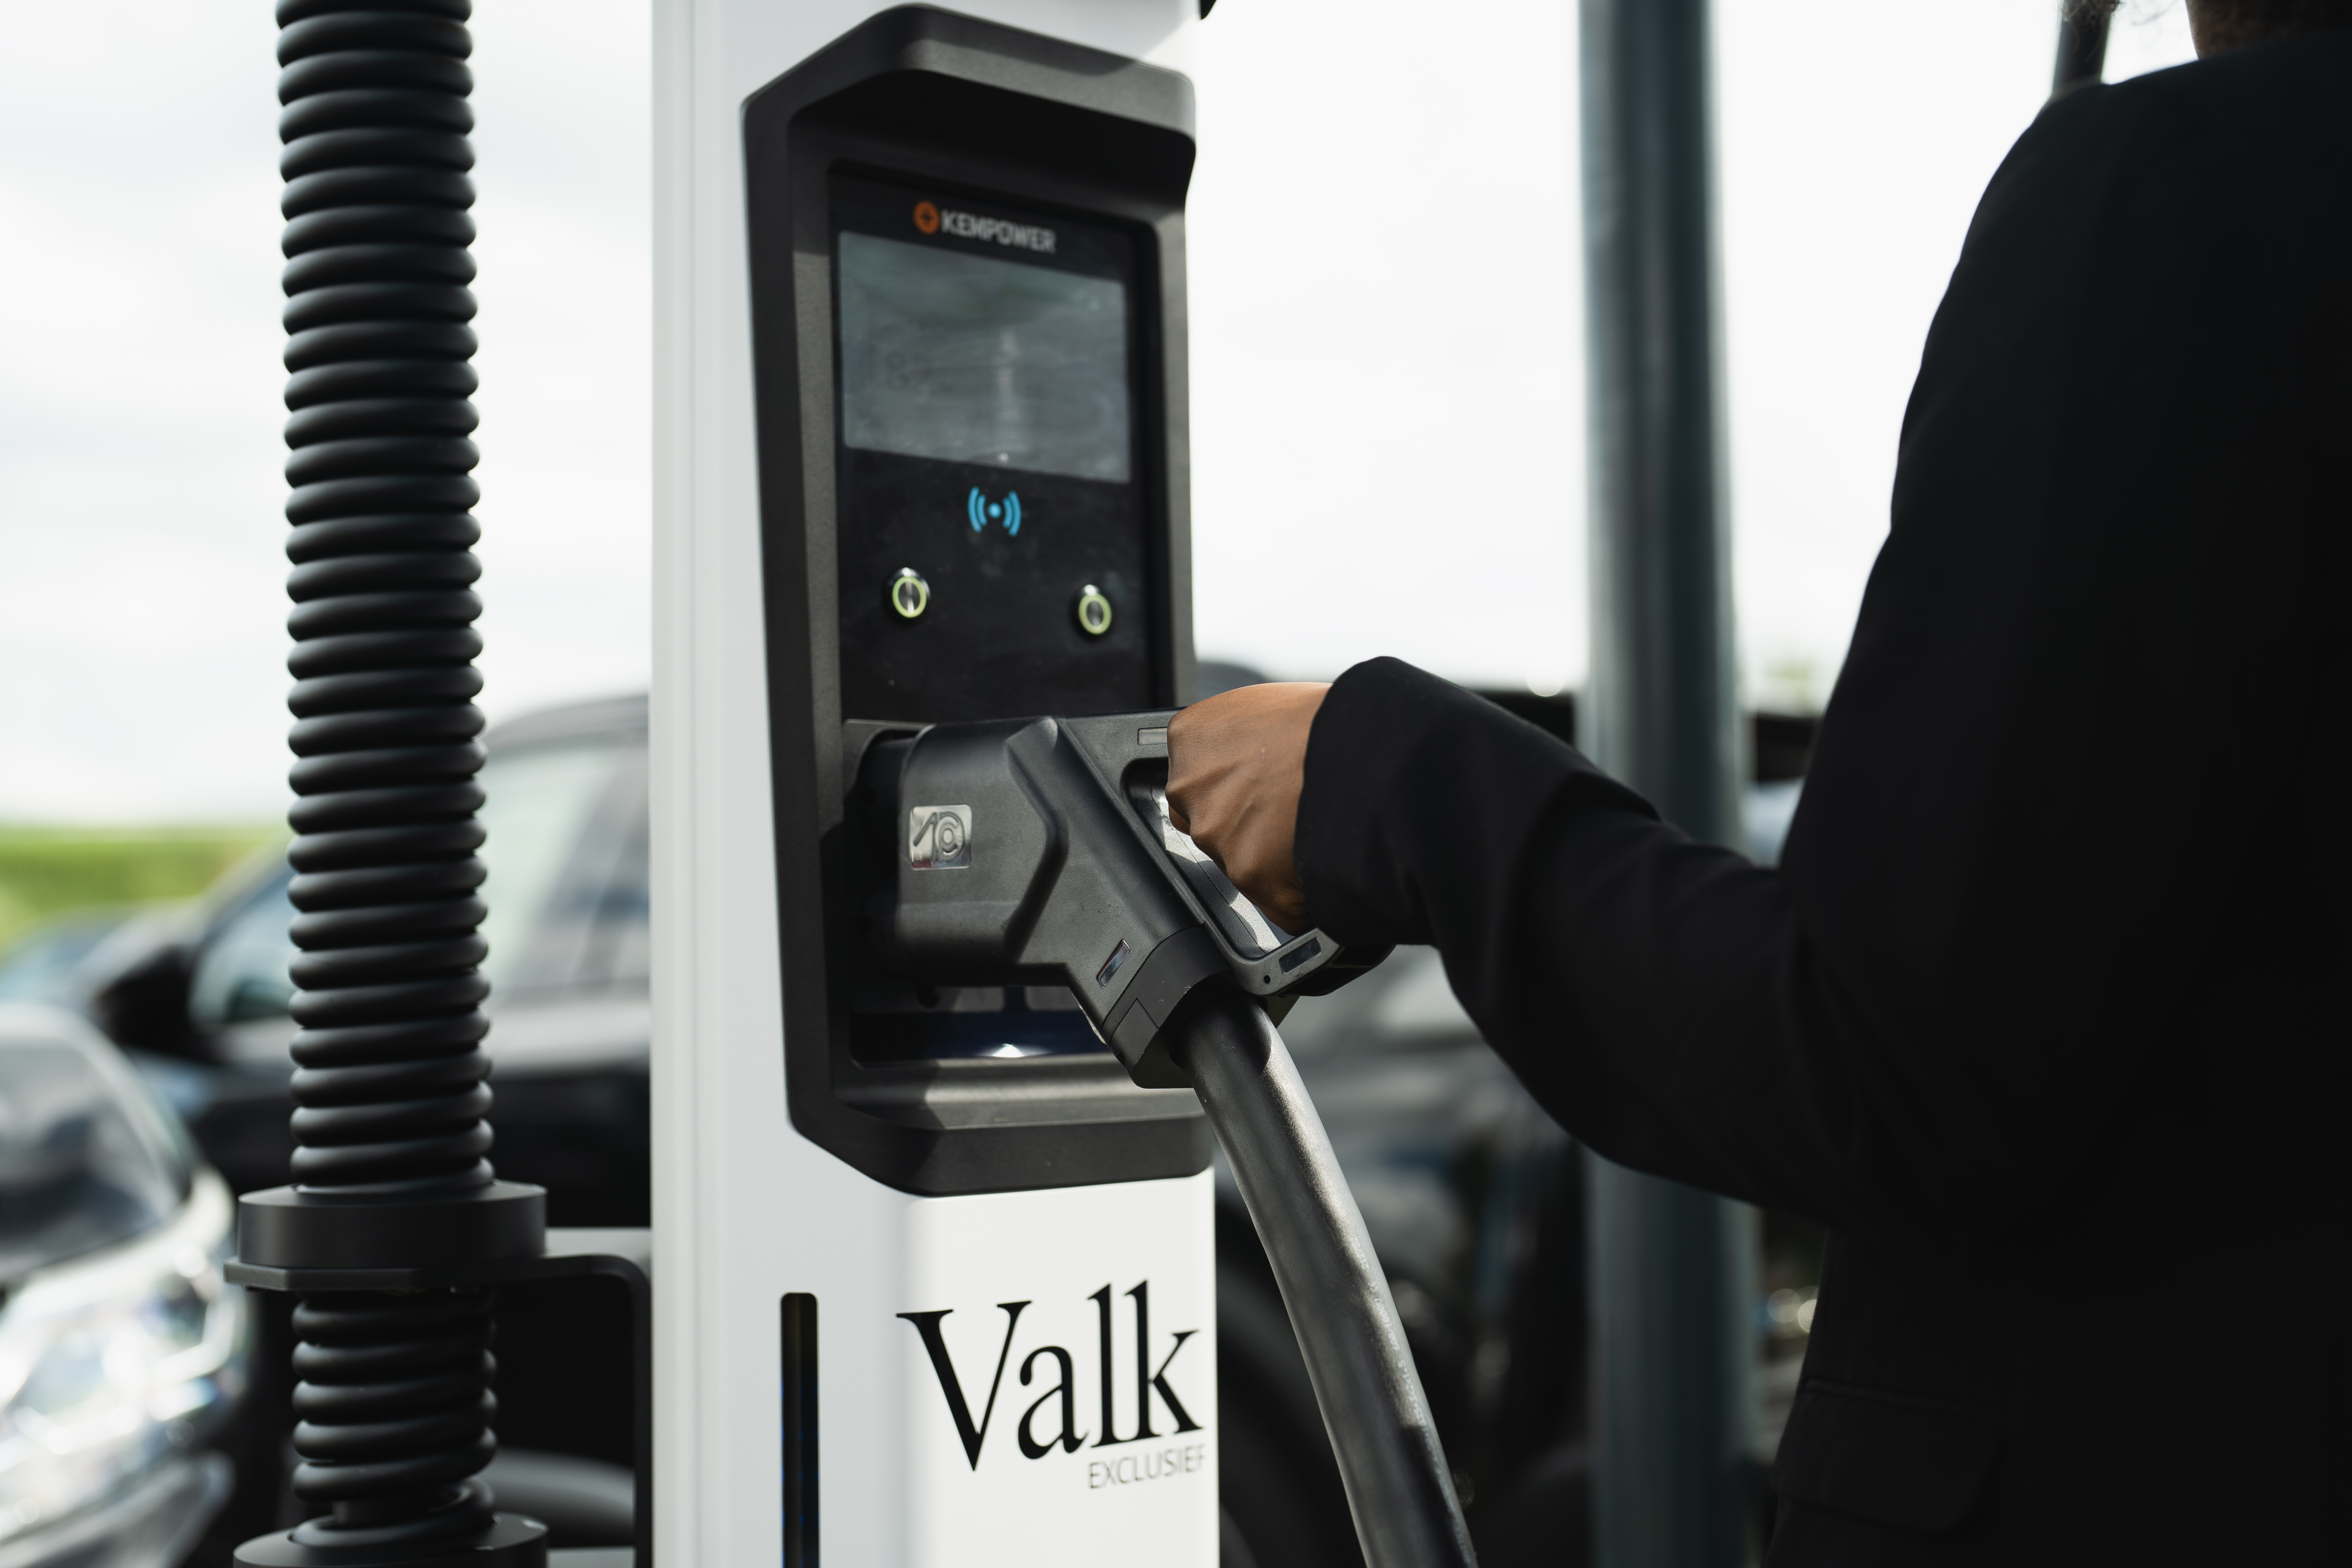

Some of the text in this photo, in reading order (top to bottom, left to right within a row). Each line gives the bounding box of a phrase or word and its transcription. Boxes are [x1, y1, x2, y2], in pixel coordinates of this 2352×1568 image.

[942, 209, 1056, 253] KEMPOWER
[896, 1280, 1204, 1471] Valk
[1090, 1445, 1205, 1489] EXCLUSIEF
